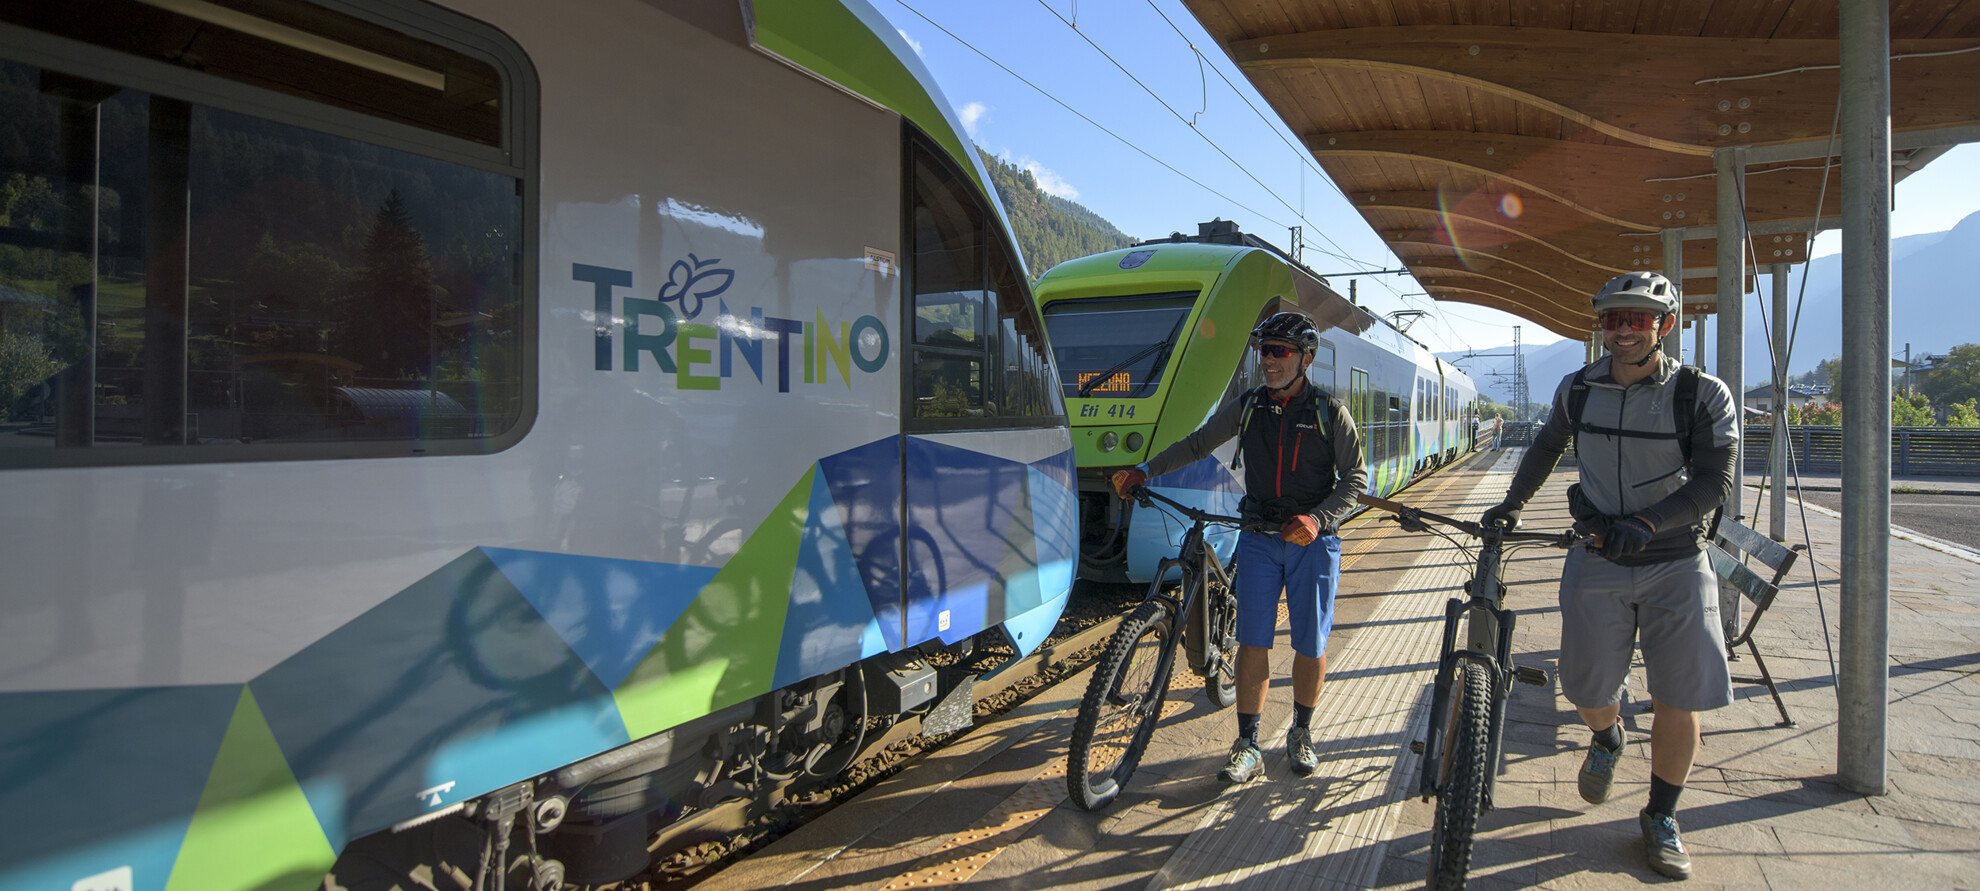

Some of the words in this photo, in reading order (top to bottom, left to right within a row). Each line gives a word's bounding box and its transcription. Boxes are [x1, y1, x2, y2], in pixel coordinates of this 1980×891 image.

[572, 262, 889, 392] TRENTINO
[1081, 404, 1099, 417] Eti
[1108, 404, 1136, 418] 414
